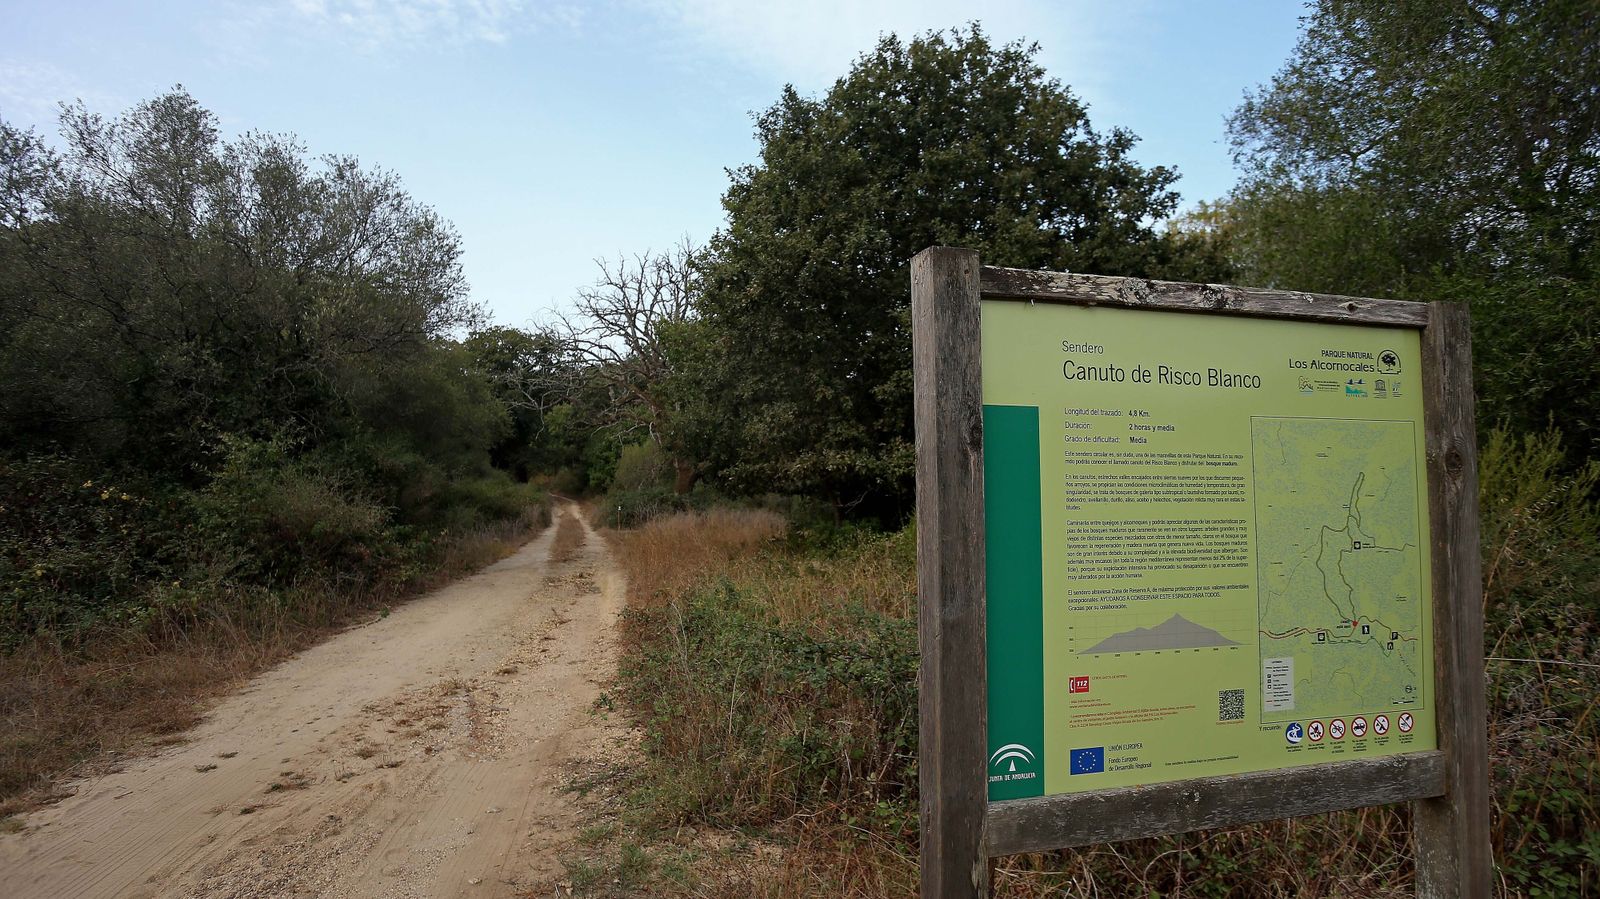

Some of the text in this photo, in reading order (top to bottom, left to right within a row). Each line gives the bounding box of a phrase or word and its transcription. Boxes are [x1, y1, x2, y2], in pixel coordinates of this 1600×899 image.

[1062, 341, 1104, 354] Sendero
[1322, 350, 1346, 358] PARQUE
[1289, 359, 1374, 372] Los Alcornocales
[1063, 360, 1261, 389] Canuto de Risco Blanco
[1065, 408, 1089, 417] Longitud
